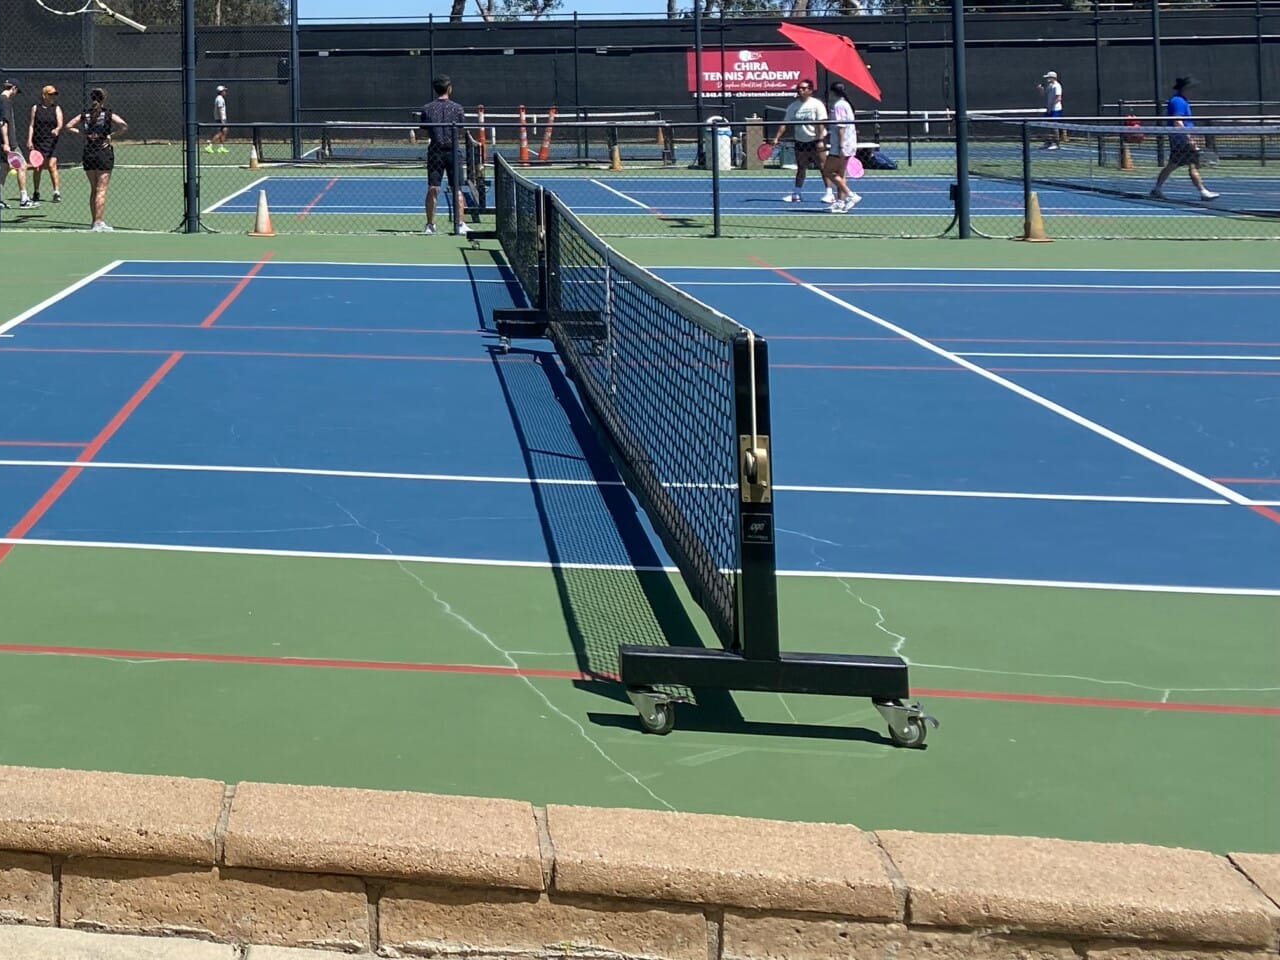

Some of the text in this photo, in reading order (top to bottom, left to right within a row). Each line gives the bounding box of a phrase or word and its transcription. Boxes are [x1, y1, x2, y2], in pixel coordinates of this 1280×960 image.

[734, 62, 769, 71] CHIRA
[704, 71, 800, 80] TENNIS ACADEMY
